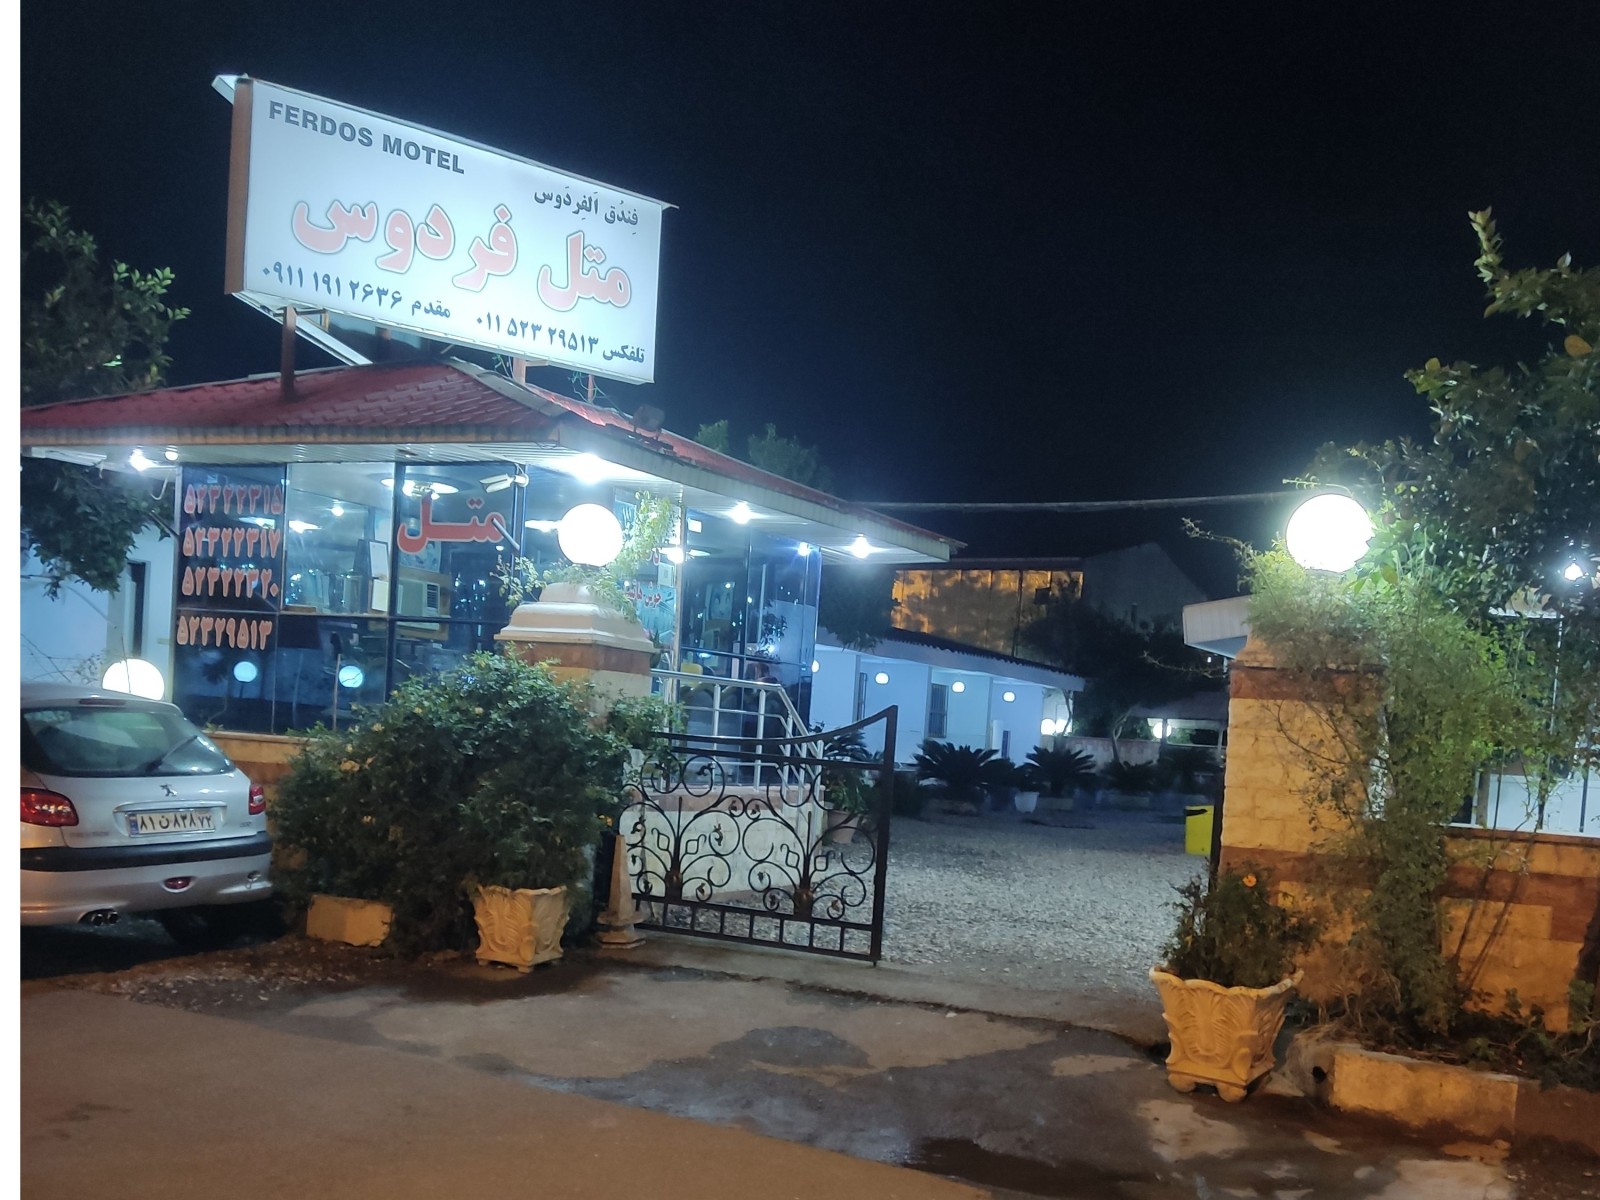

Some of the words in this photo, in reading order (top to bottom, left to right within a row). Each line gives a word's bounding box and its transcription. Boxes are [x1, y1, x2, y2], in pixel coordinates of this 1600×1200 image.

[269, 100, 373, 147] FERDOS
[382, 133, 465, 175] MOTEL
[292, 200, 519, 293] فردوس
[262, 261, 304, 288] ۰۹۱۱
[313, 271, 341, 297] ۱۹۱
[537, 230, 631, 312] متل
[349, 280, 402, 309] ۲۶۳۶
[411, 300, 451, 319] مقدم
[476, 312, 501, 333] ۰۱۱
[507, 317, 542, 341] ۵۲۳
[548, 326, 599, 354] ۲۹۵۱۳
[602, 345, 645, 363] تلفکس
[183, 484, 283, 515] ۵۲۳۲۲۳۱۵
[397, 491, 506, 555] متل
[182, 527, 281, 559] ۵۲۳۲۲۳۱۷
[181, 566, 279, 600] ۵۲۳۲۲۳۲۰
[176, 615, 273, 650] ۵۲۳۲۹۵۱۳
